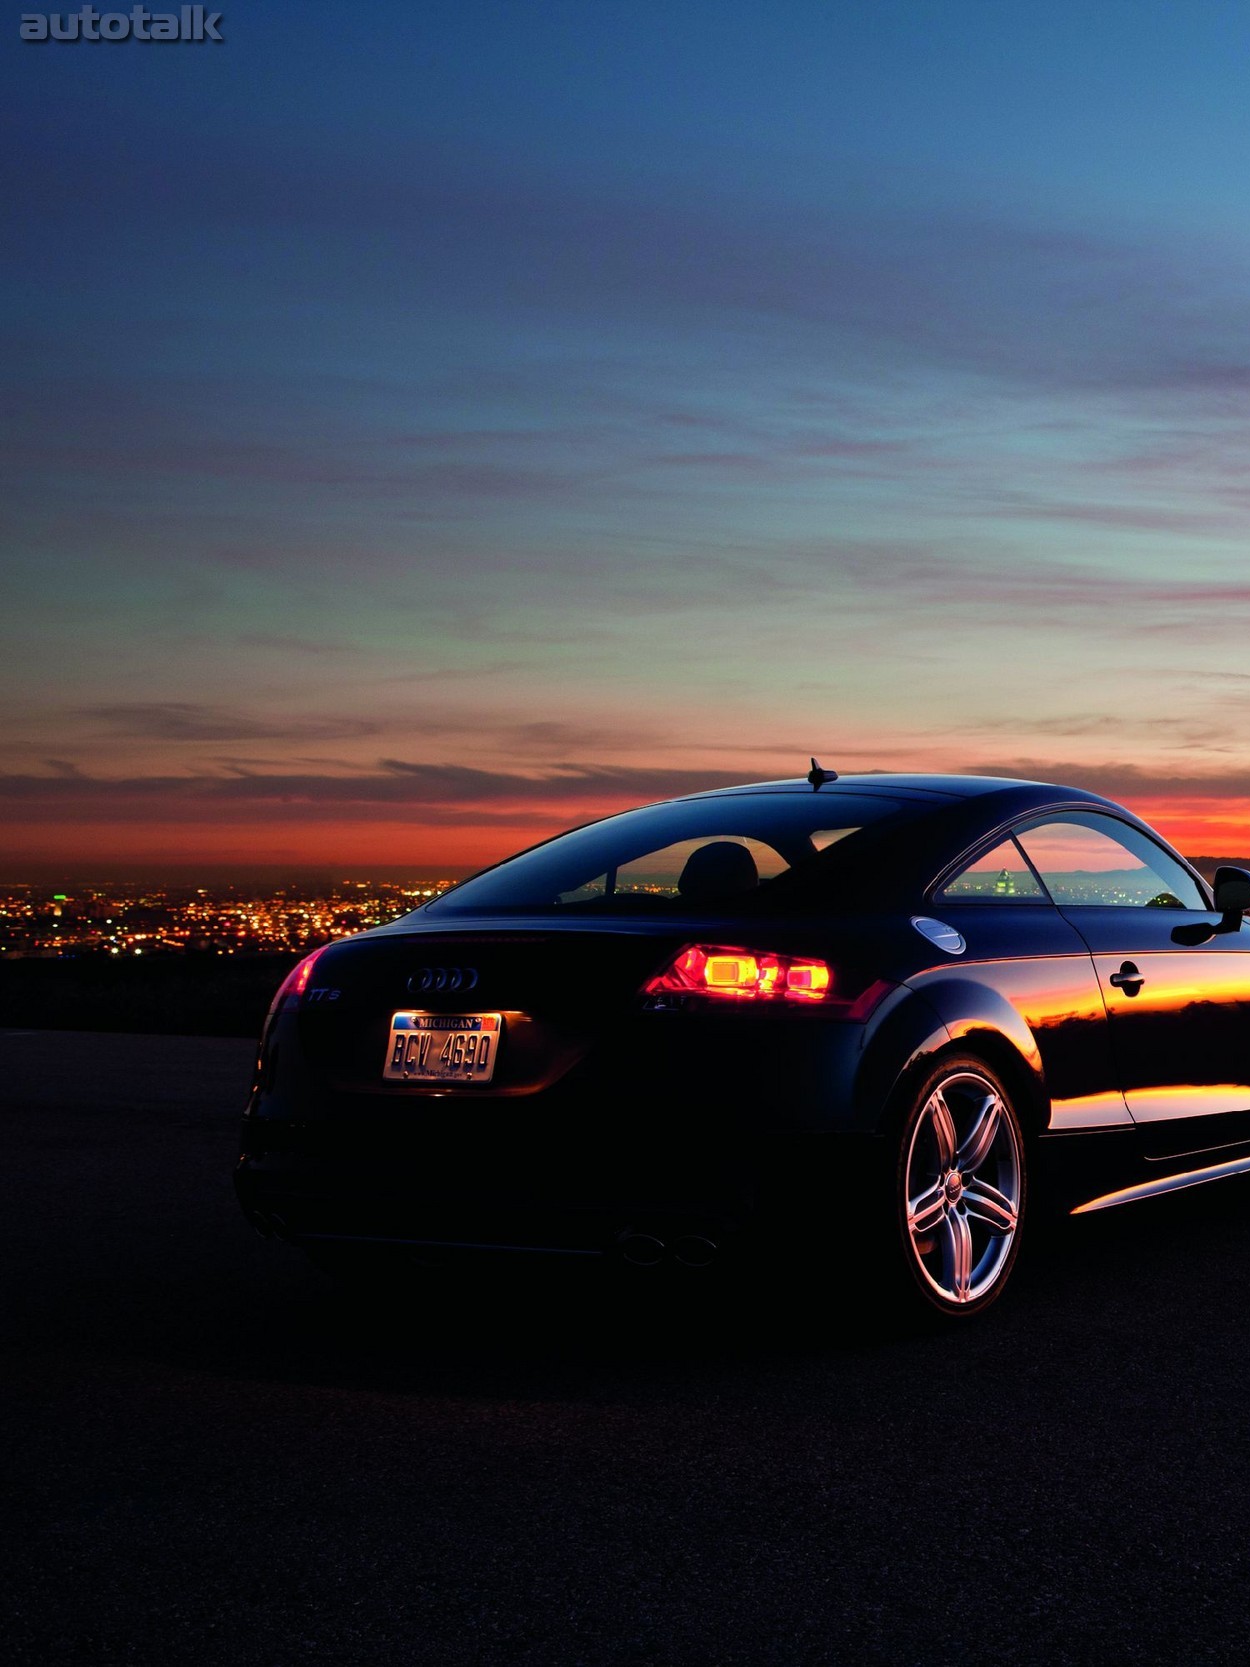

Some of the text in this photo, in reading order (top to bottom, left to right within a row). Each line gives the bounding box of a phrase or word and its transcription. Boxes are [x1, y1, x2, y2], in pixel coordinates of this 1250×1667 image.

[419, 1018, 474, 1029] MICHIGAN
[392, 1033, 492, 1067] BCV 4690
